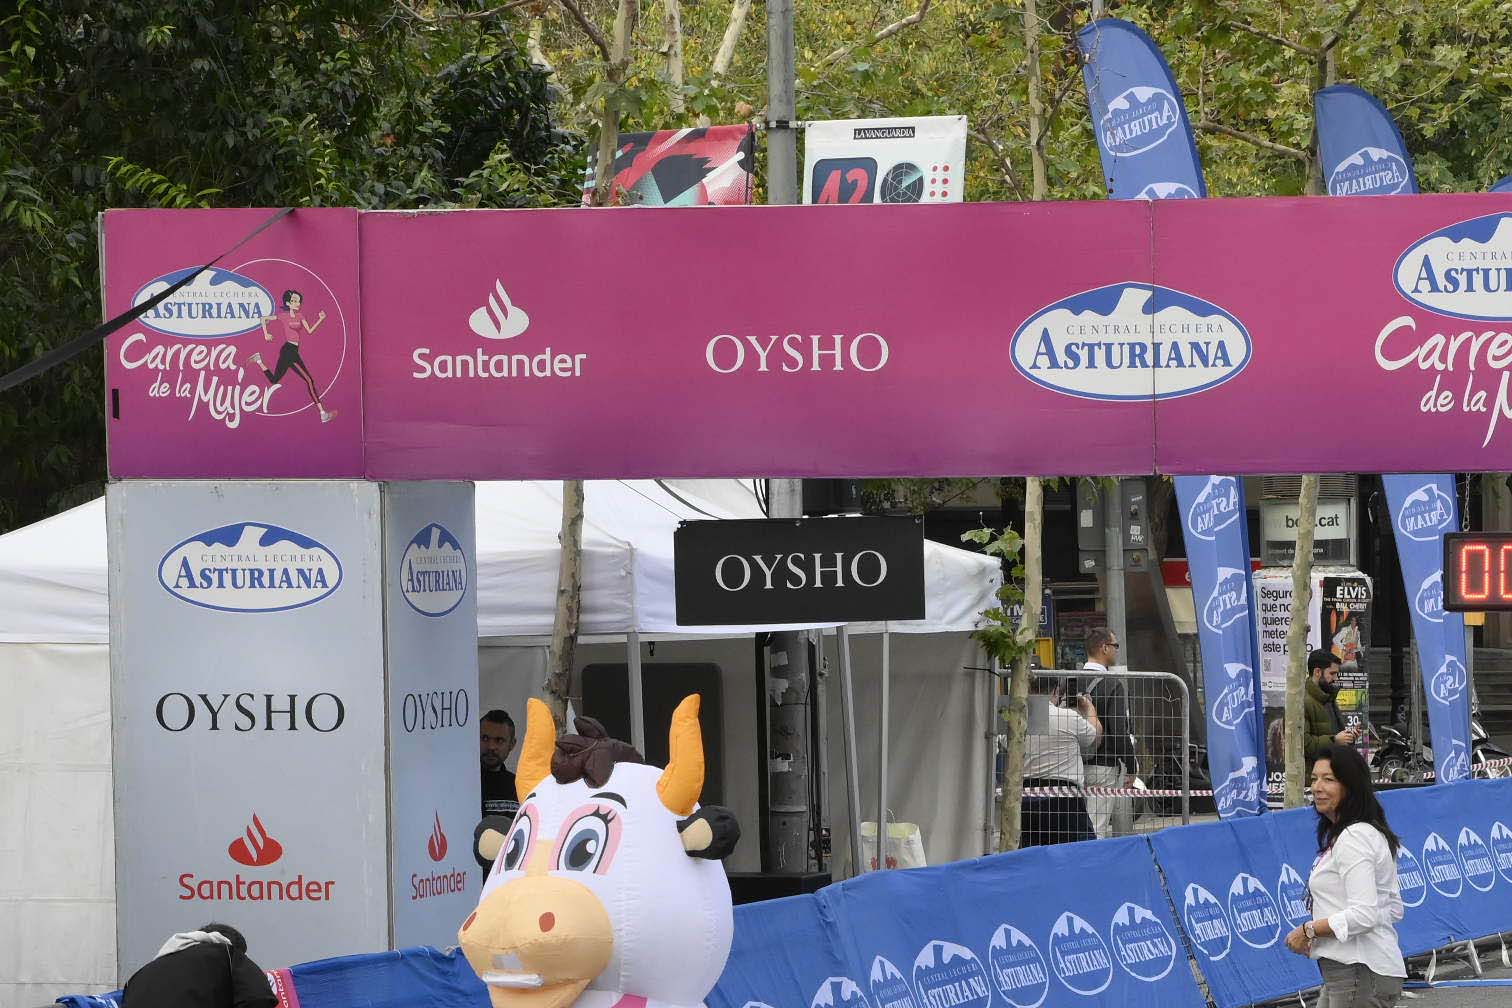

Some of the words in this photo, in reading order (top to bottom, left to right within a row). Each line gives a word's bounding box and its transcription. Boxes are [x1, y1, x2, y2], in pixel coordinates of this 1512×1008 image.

[865, 128, 914, 138] VANGUARDIA
[144, 292, 264, 320] ASTURIANA
[172, 290, 210, 299] ENTRAL
[1065, 323, 1144, 335] CENTRAL
[1149, 322, 1225, 334] LECHERA
[119, 332, 238, 371] Carrera
[411, 346, 587, 379] Santander
[705, 332, 890, 375] OYSHO
[1029, 326, 1234, 371] ASTURIANA
[149, 371, 171, 398] de
[175, 371, 191, 398] la
[187, 367, 283, 429] Mujer
[1420, 374, 1455, 413] de
[1462, 371, 1487, 413] la
[173, 556, 329, 591] ASTURIANA
[200, 554, 260, 564] CENTRAL
[264, 553, 324, 563] LECHERA
[714, 549, 889, 592] OYSHO
[405, 558, 464, 594] ASTURIANA
[1336, 585, 1367, 599] ELVIS
[1261, 602, 1278, 614] que
[1263, 642, 1281, 653] este
[155, 691, 346, 733] OYSHO
[402, 688, 470, 734] OYSHO
[178, 873, 336, 903] Santander
[410, 870, 468, 902] Santander
[994, 958, 1047, 991] ASTURIANA
